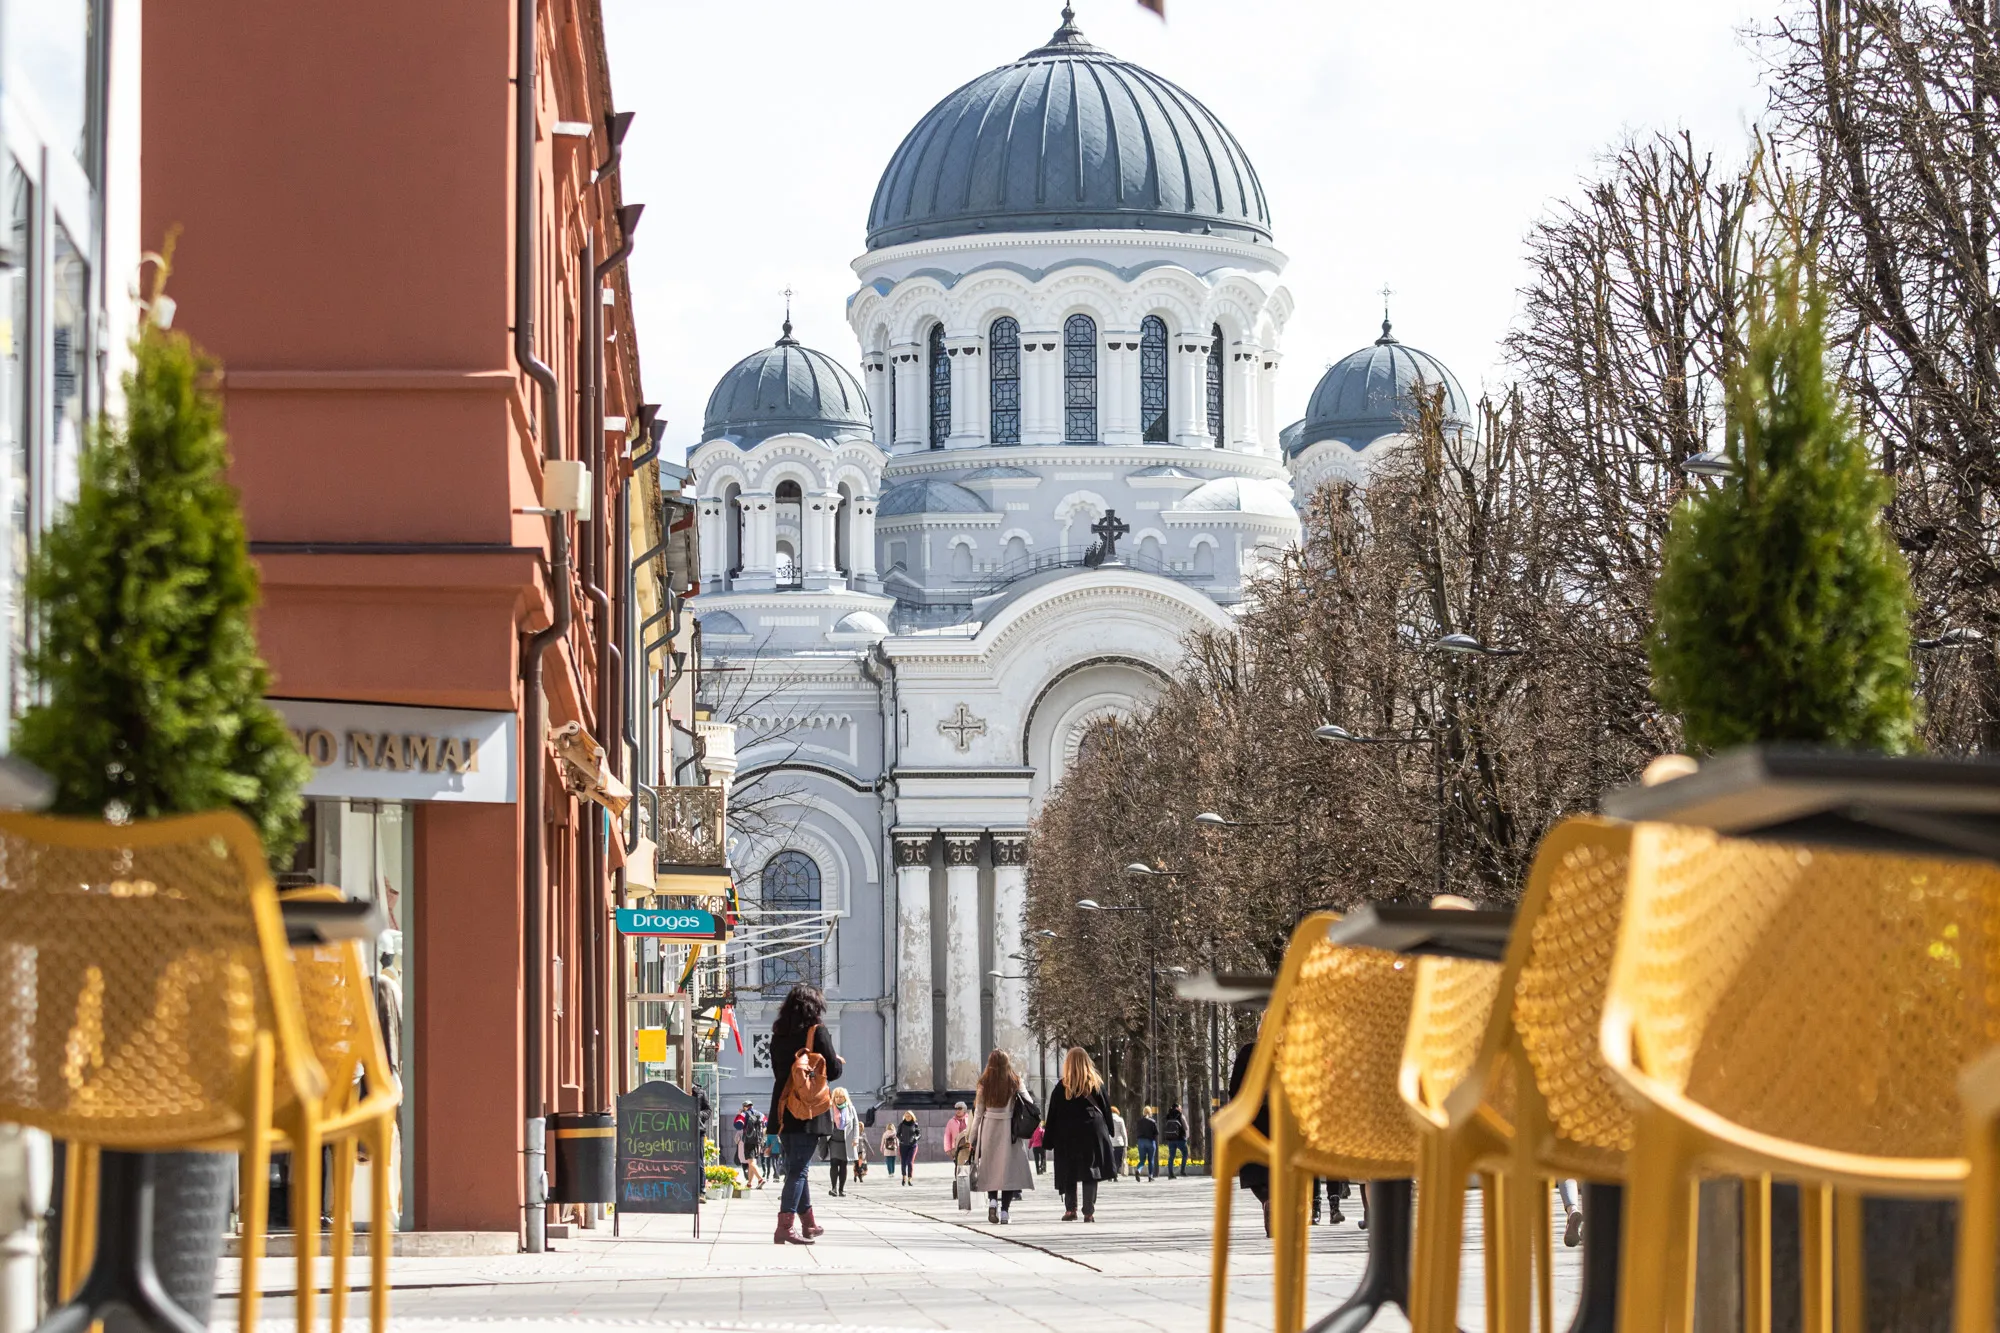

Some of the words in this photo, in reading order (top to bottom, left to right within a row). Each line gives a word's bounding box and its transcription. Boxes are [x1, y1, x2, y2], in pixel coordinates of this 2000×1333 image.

[351, 732, 480, 773] NAMAI
[633, 913, 700, 930] Drogas
[627, 1111, 690, 1134] VEGAN
[624, 1136, 696, 1157] Vegetarian
[624, 1181, 693, 1202] ARBATOS
